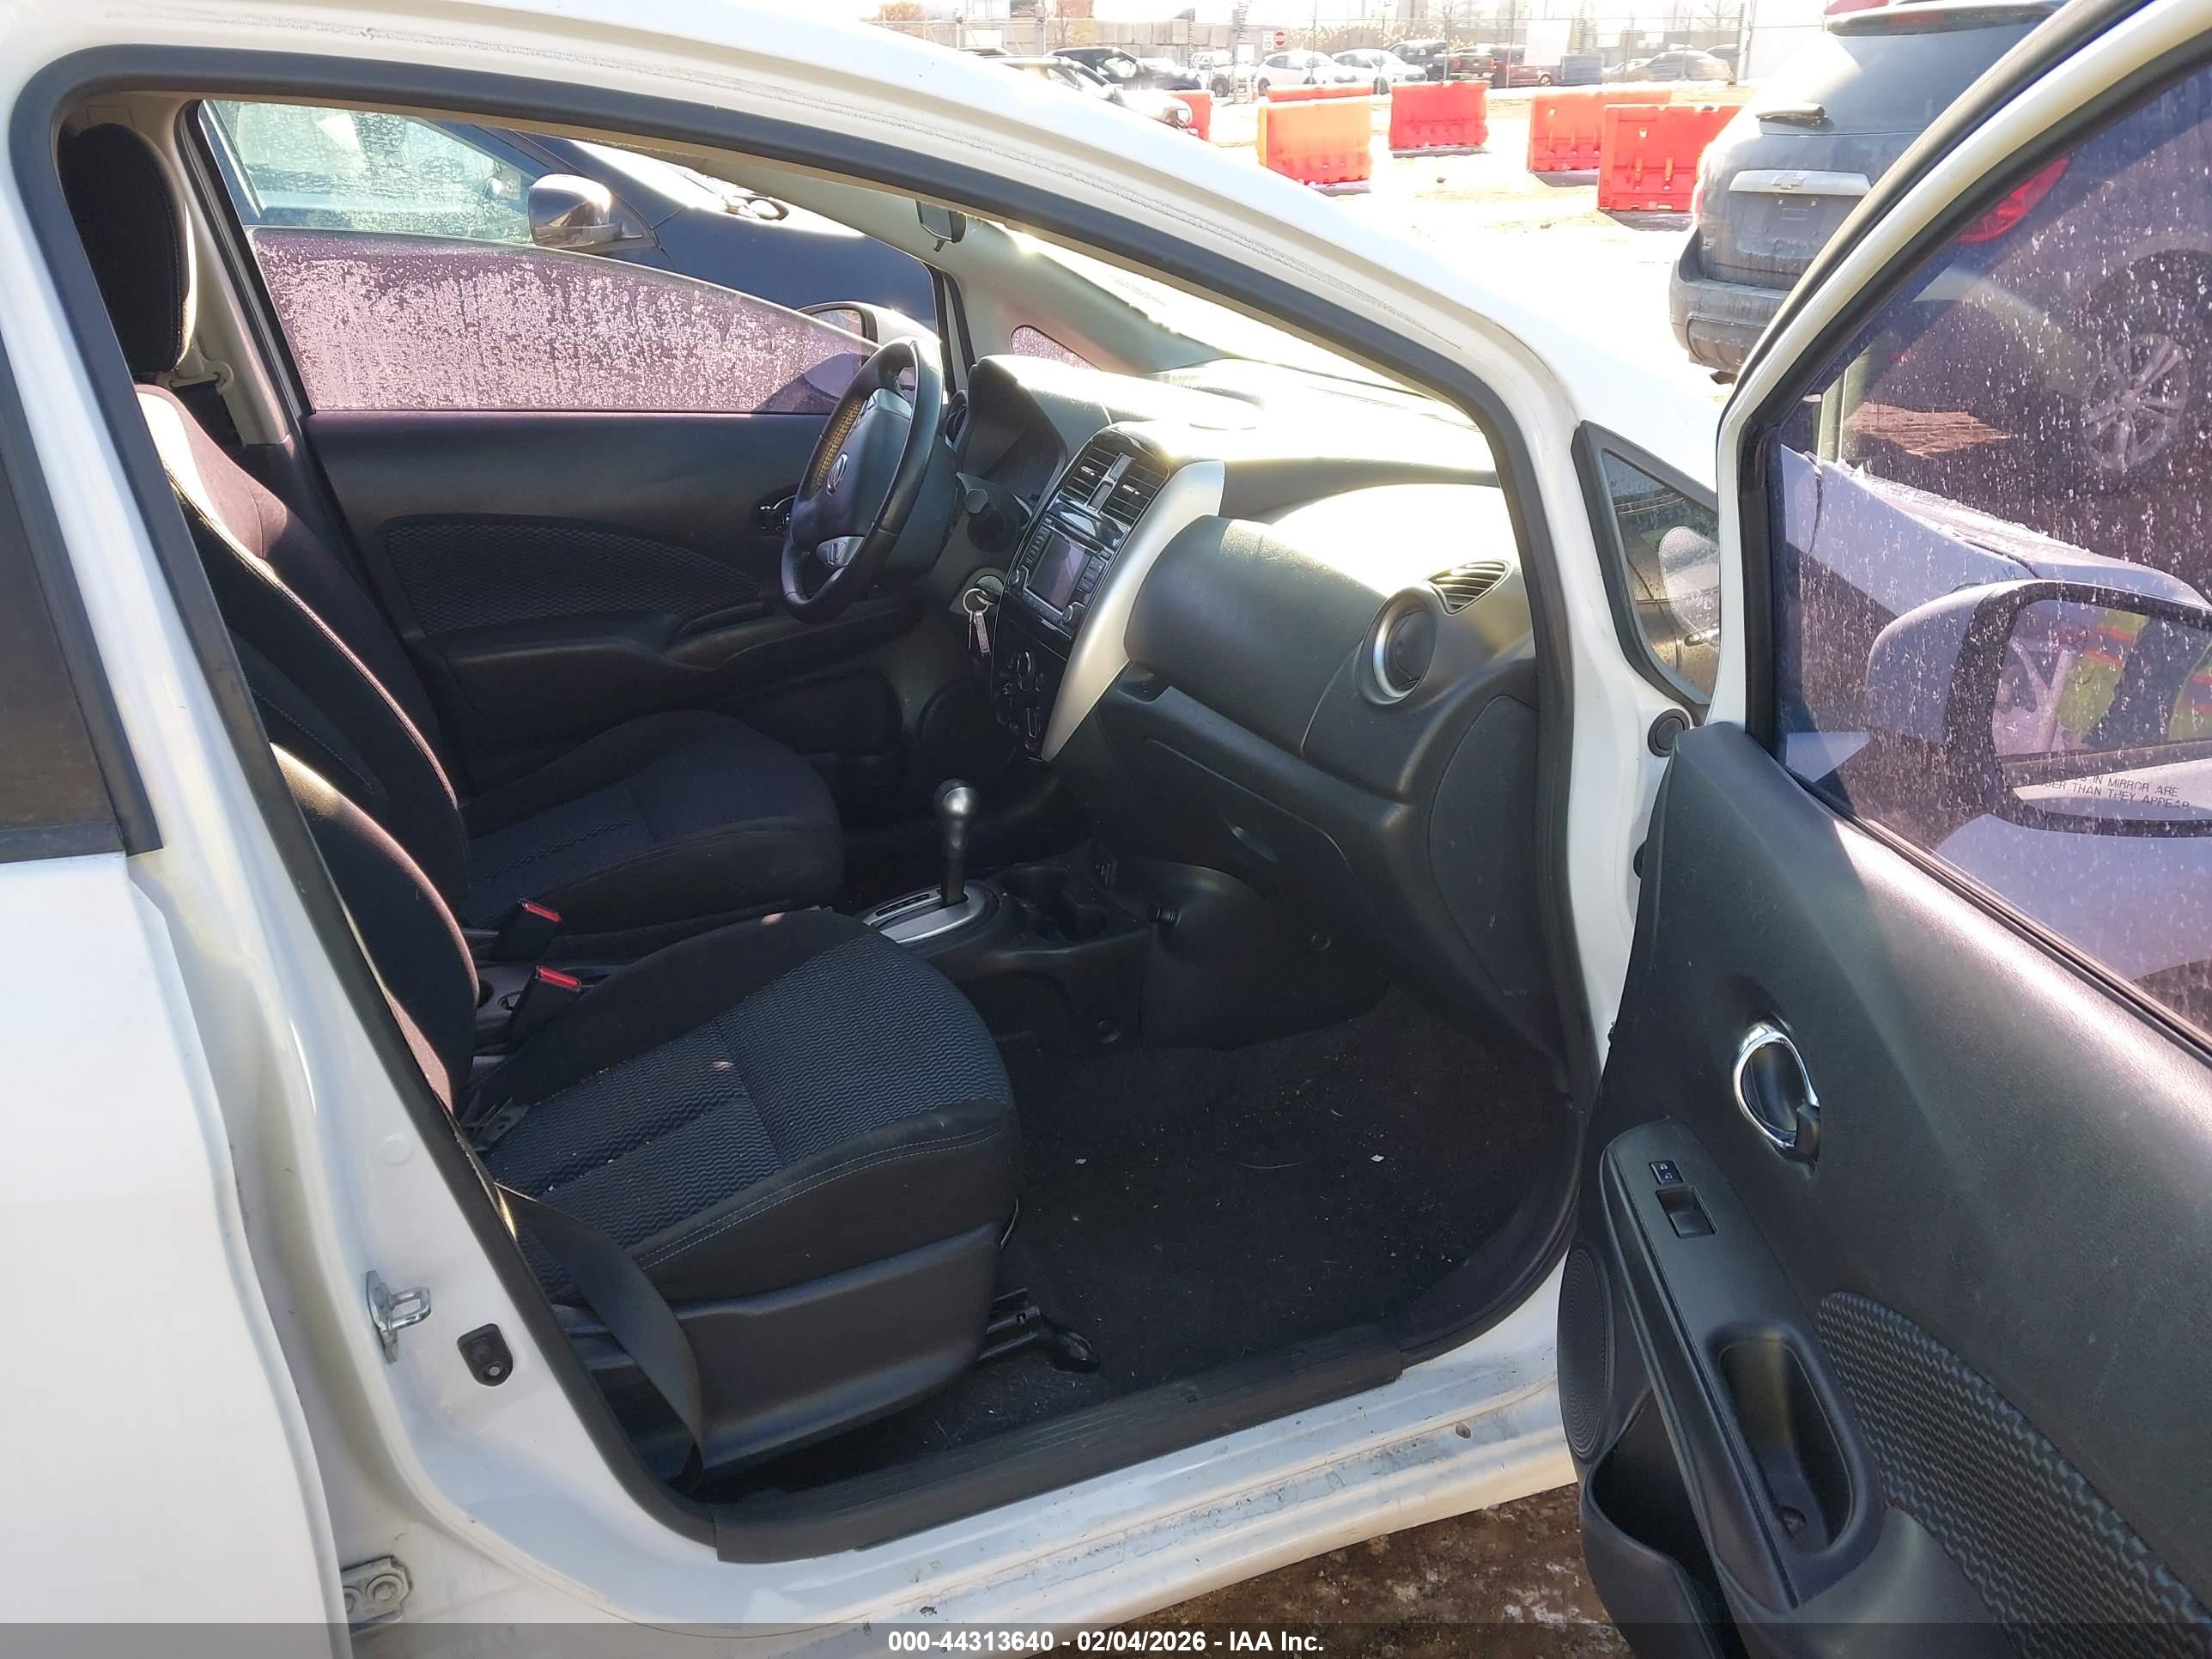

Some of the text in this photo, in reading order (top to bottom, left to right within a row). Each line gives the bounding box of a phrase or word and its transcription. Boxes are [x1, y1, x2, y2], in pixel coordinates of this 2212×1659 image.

[2073, 783, 2102, 796] THAN
[2108, 789, 2136, 802] THEY
[2142, 795, 2190, 811] APPEAR
[2093, 776, 2103, 785] IN
[2108, 778, 2150, 792] MIRROR
[2154, 786, 2179, 798] ARE
